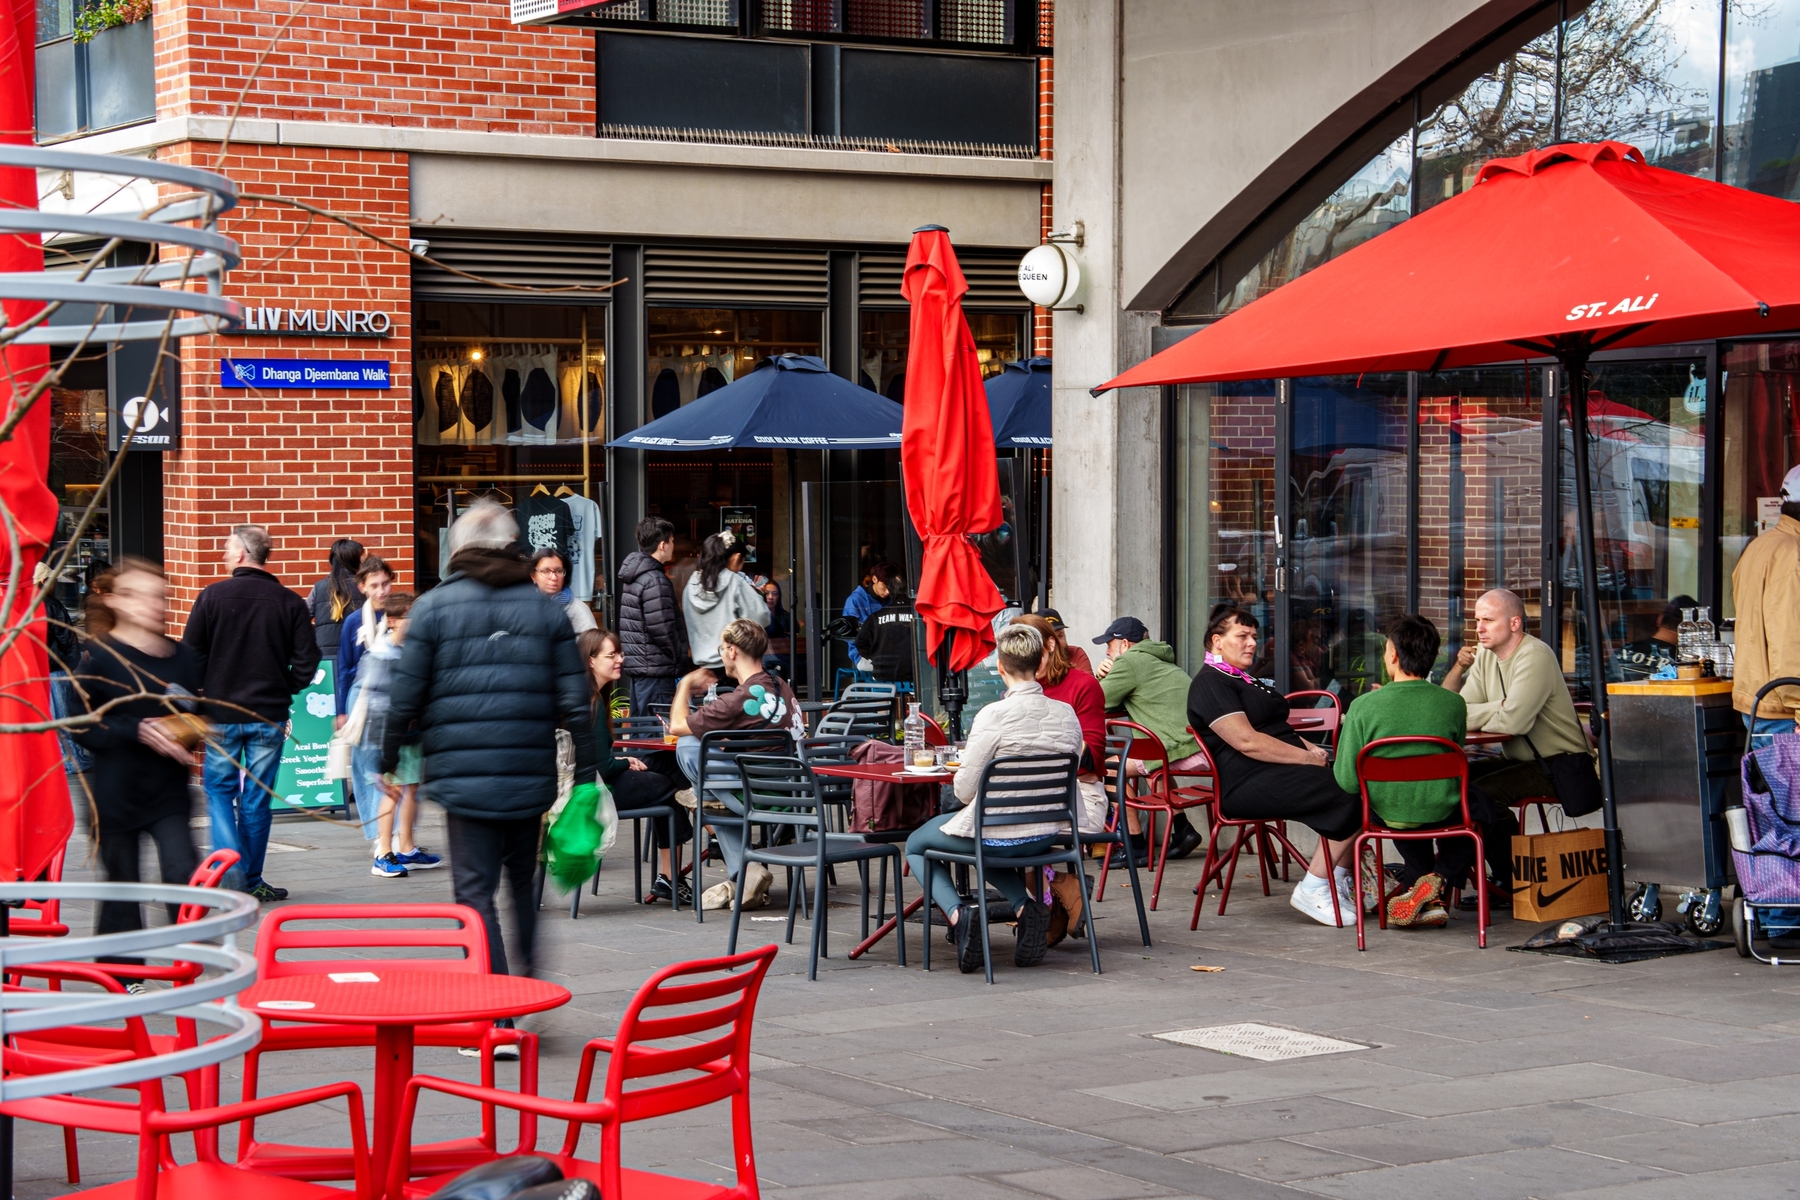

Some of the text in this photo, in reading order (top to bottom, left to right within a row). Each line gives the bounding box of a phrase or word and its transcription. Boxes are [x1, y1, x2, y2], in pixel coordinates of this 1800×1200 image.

[1022, 273, 1048, 281] QUEEN
[1565, 301, 1607, 321] ST.
[245, 307, 391, 333] LIV MUNRO
[263, 367, 386, 383] Dhanga Djeembana Walk
[753, 435, 829, 445] CODE BLACK COFFEE
[878, 613, 897, 625] TEAM
[294, 742, 330, 751] Acai Bowl
[280, 754, 331, 764] Greek Yoghurt
[297, 779, 333, 787] Superfood
[1559, 848, 1608, 879] NIKE
